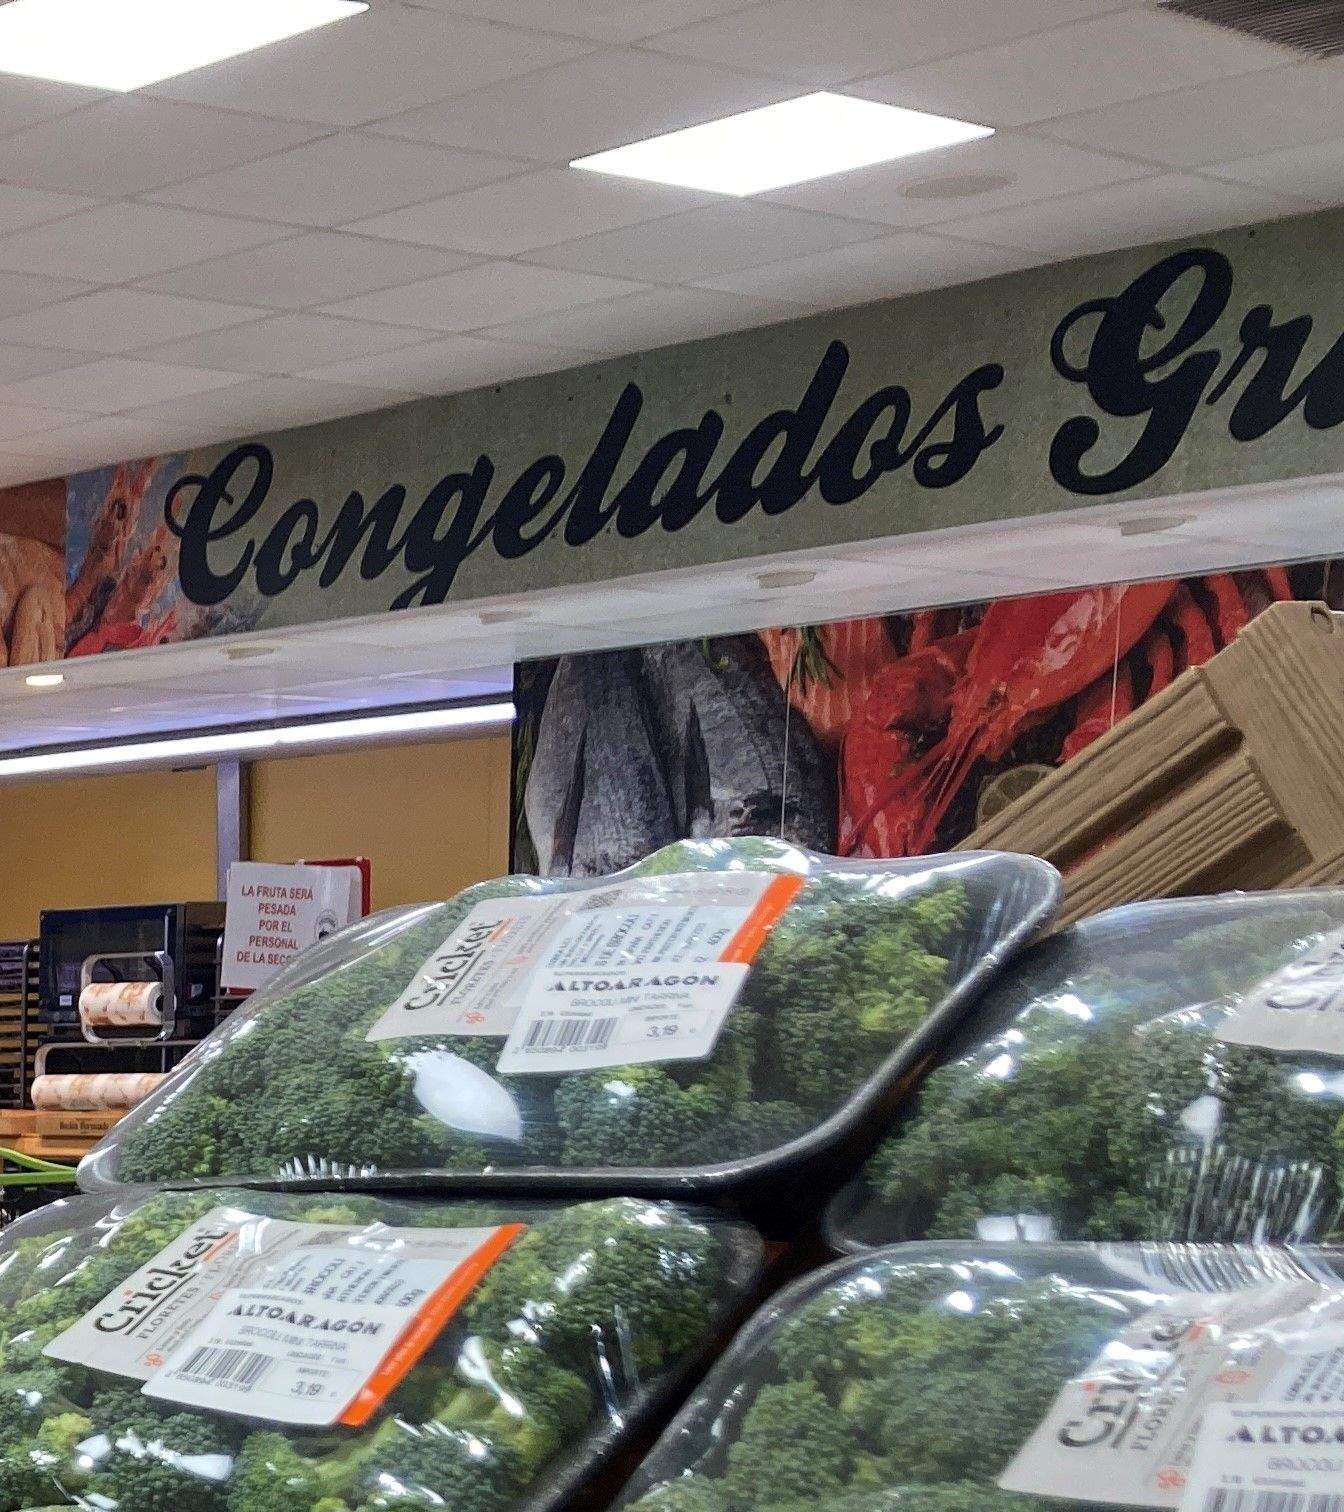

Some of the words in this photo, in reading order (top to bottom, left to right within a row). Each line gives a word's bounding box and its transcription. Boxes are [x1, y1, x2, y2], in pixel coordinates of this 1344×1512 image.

[163, 339, 1007, 612] Congelados
[242, 884, 254, 897] LA
[257, 886, 287, 899] FRUTA
[258, 903, 296, 916] PESADA
[259, 920, 278, 932] POR
[281, 921, 292, 933] EL
[249, 935, 298, 950] PERSONAL
[236, 952, 250, 962] DE
[253, 953, 265, 964] LA
[94, 1227, 229, 1333] Cricket
